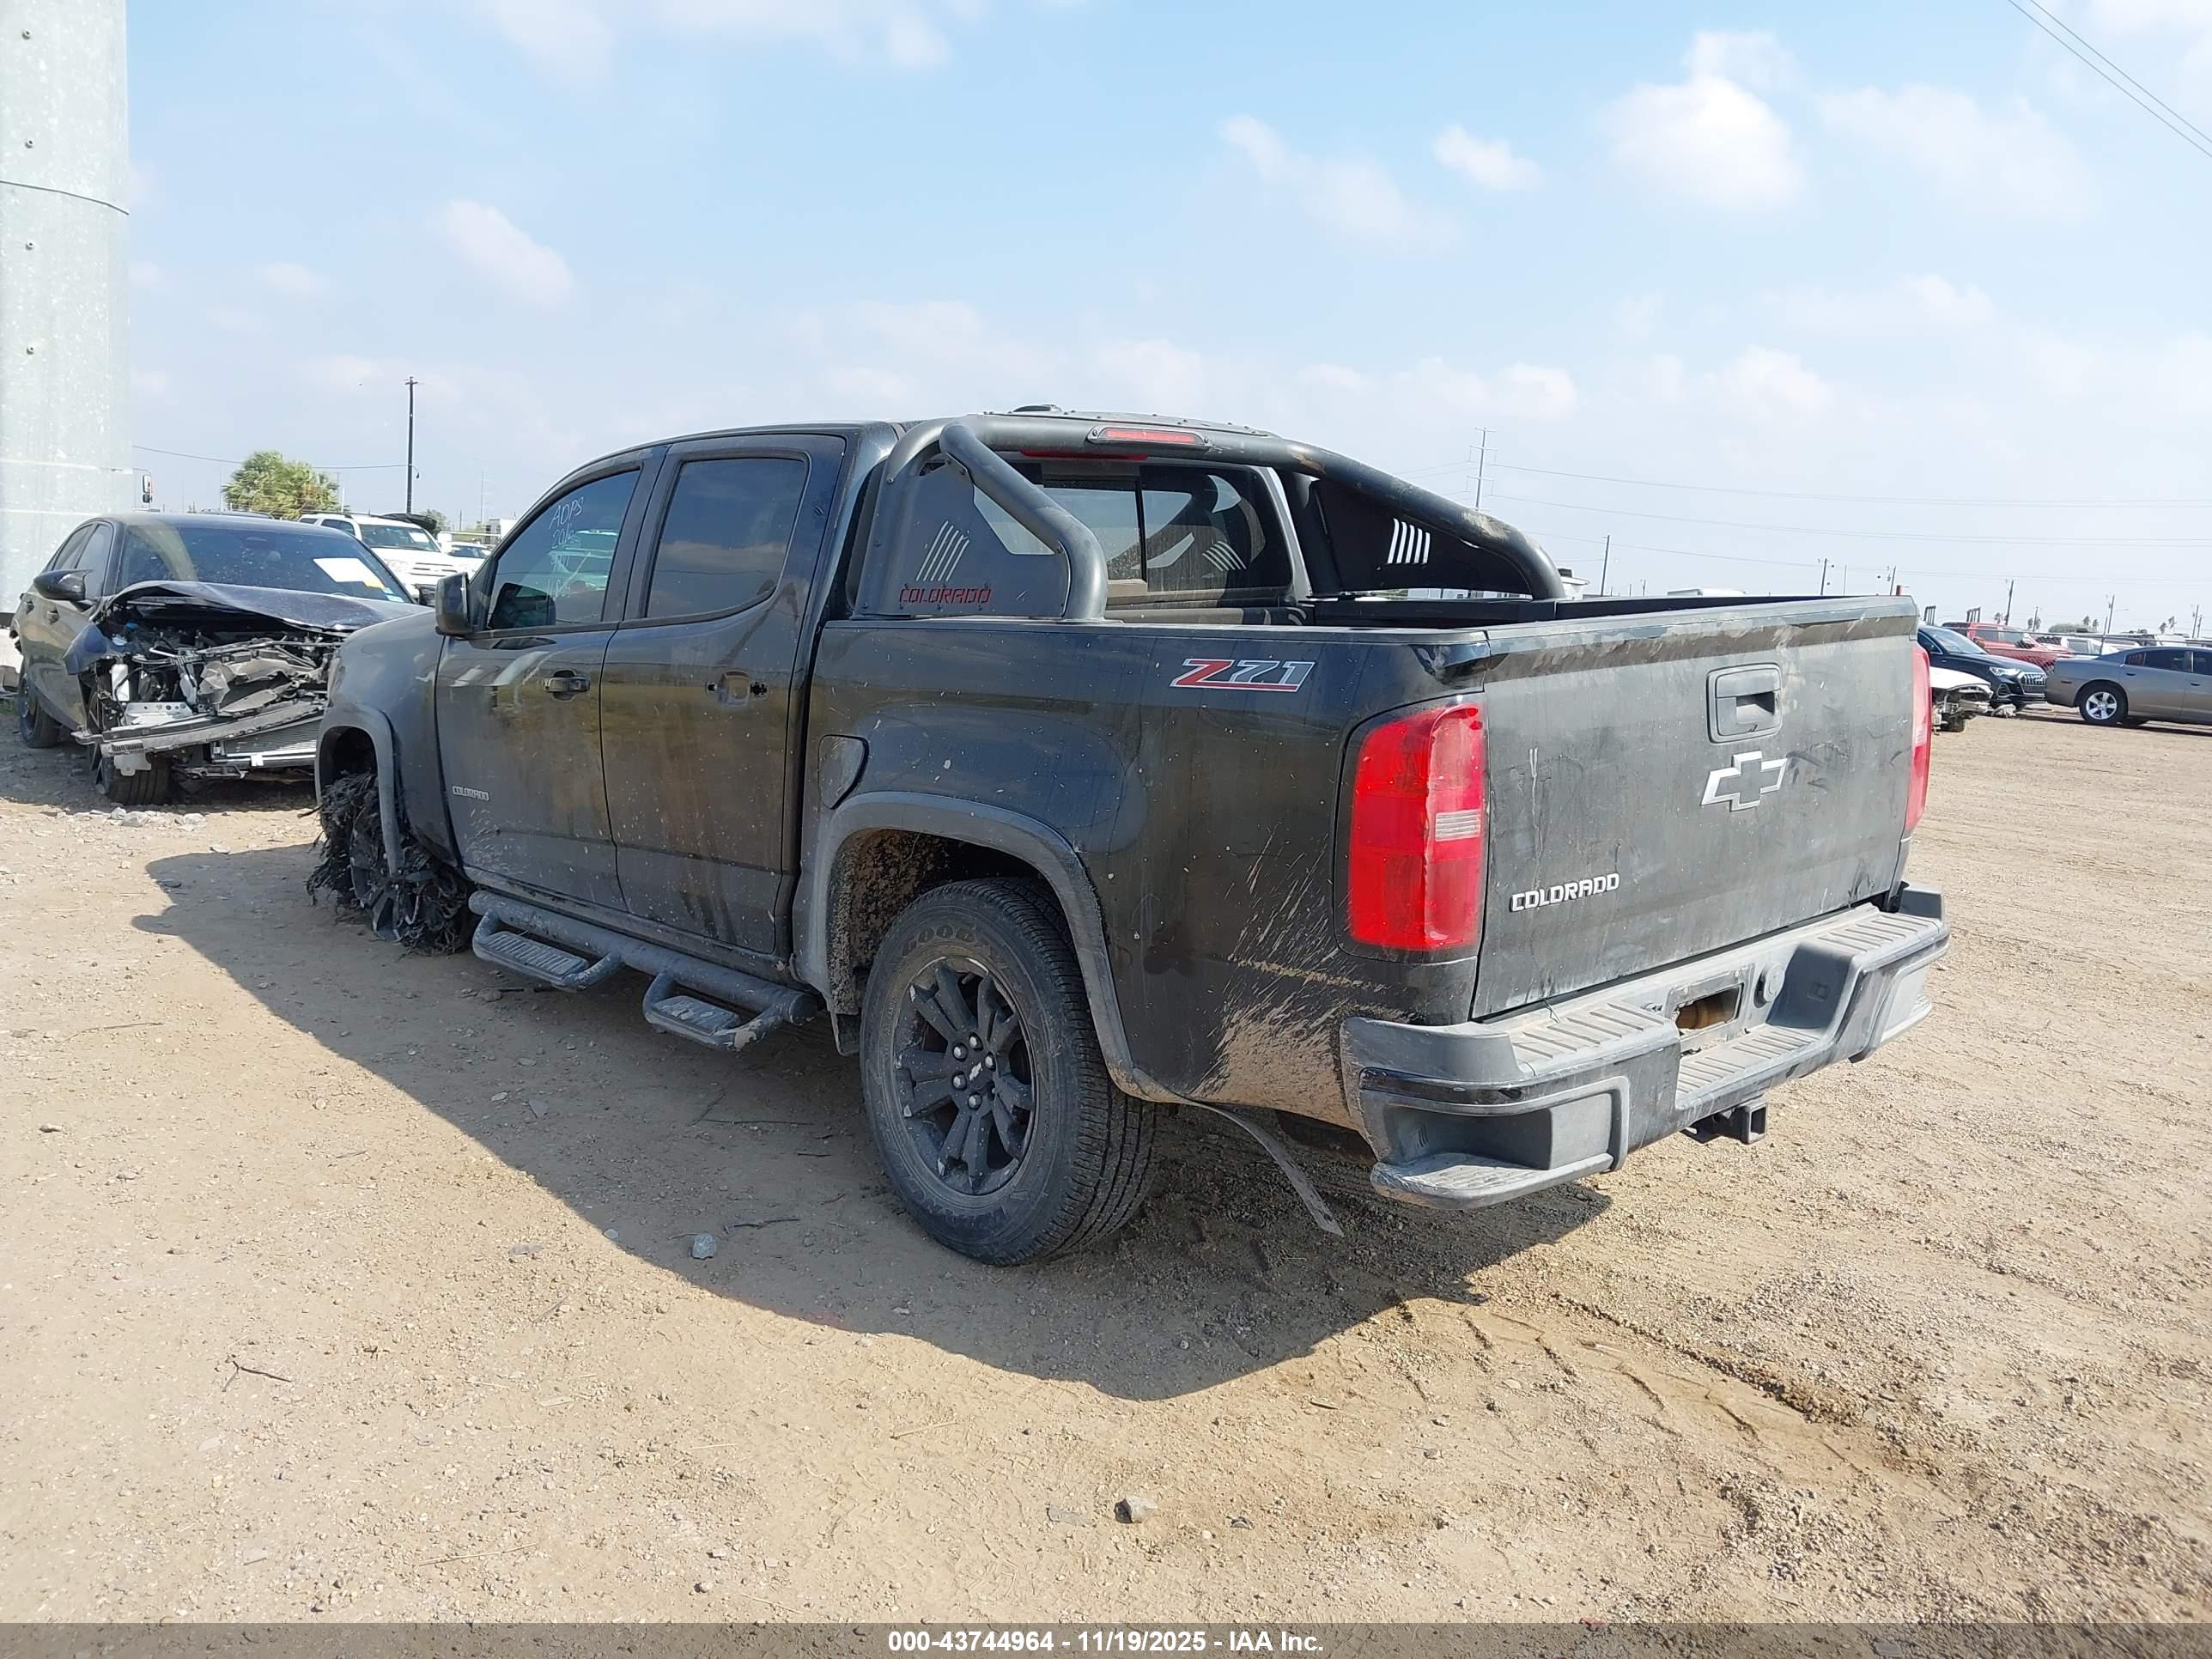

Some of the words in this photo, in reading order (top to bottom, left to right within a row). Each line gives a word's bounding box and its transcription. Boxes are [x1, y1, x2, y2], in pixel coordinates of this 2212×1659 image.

[898, 587, 993, 605] COLORADO
[1170, 658, 1316, 692] Z71
[1510, 872, 1620, 913] COLORADO
